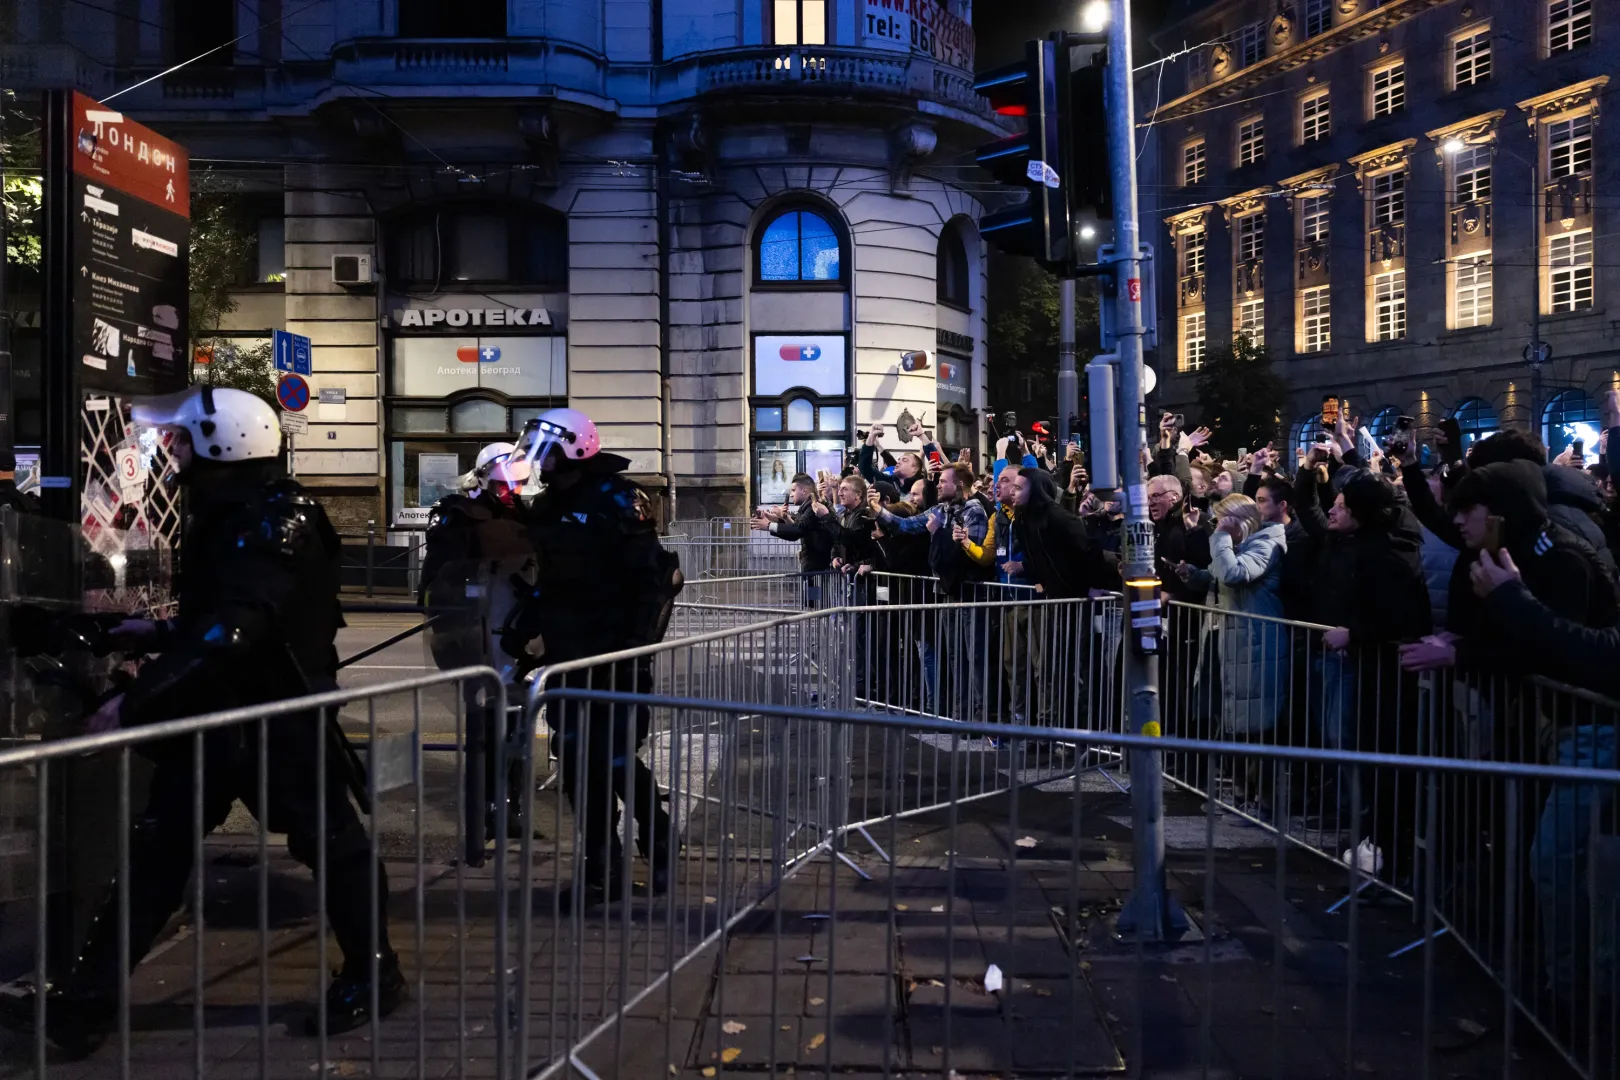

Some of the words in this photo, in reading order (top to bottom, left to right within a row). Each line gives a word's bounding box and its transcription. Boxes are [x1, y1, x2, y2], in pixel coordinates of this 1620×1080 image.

[866, 13, 900, 39] Tel:
[911, 19, 937, 57] 060
[92, 120, 175, 174] ЛОНДОН
[92, 217, 119, 235] Теразије
[91, 272, 107, 284] Кнез
[107, 276, 140, 293] Михаилова
[400, 308, 552, 327] APOTEKA
[437, 366, 477, 375] Апотека
[481, 365, 521, 376] Београд
[125, 457, 135, 477] 3
[398, 511, 430, 519] Апотек
